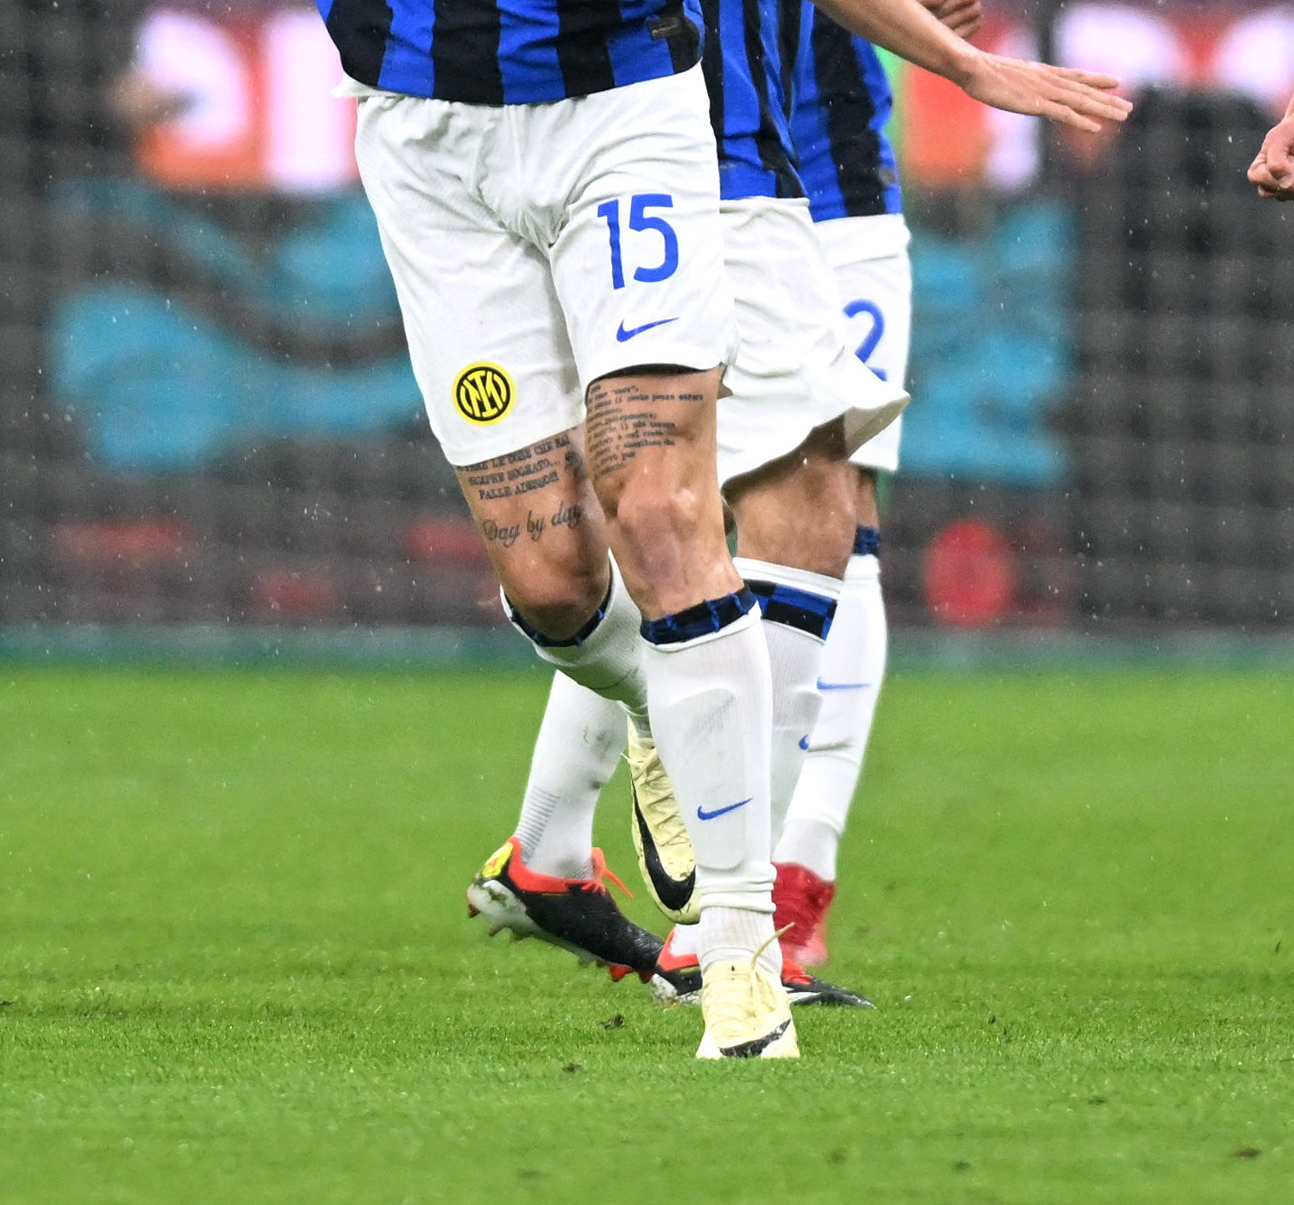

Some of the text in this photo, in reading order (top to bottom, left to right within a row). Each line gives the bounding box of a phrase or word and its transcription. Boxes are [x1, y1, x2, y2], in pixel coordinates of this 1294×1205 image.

[597, 194, 680, 291] 15
[482, 518, 521, 548] Day
[527, 510, 546, 542] by
